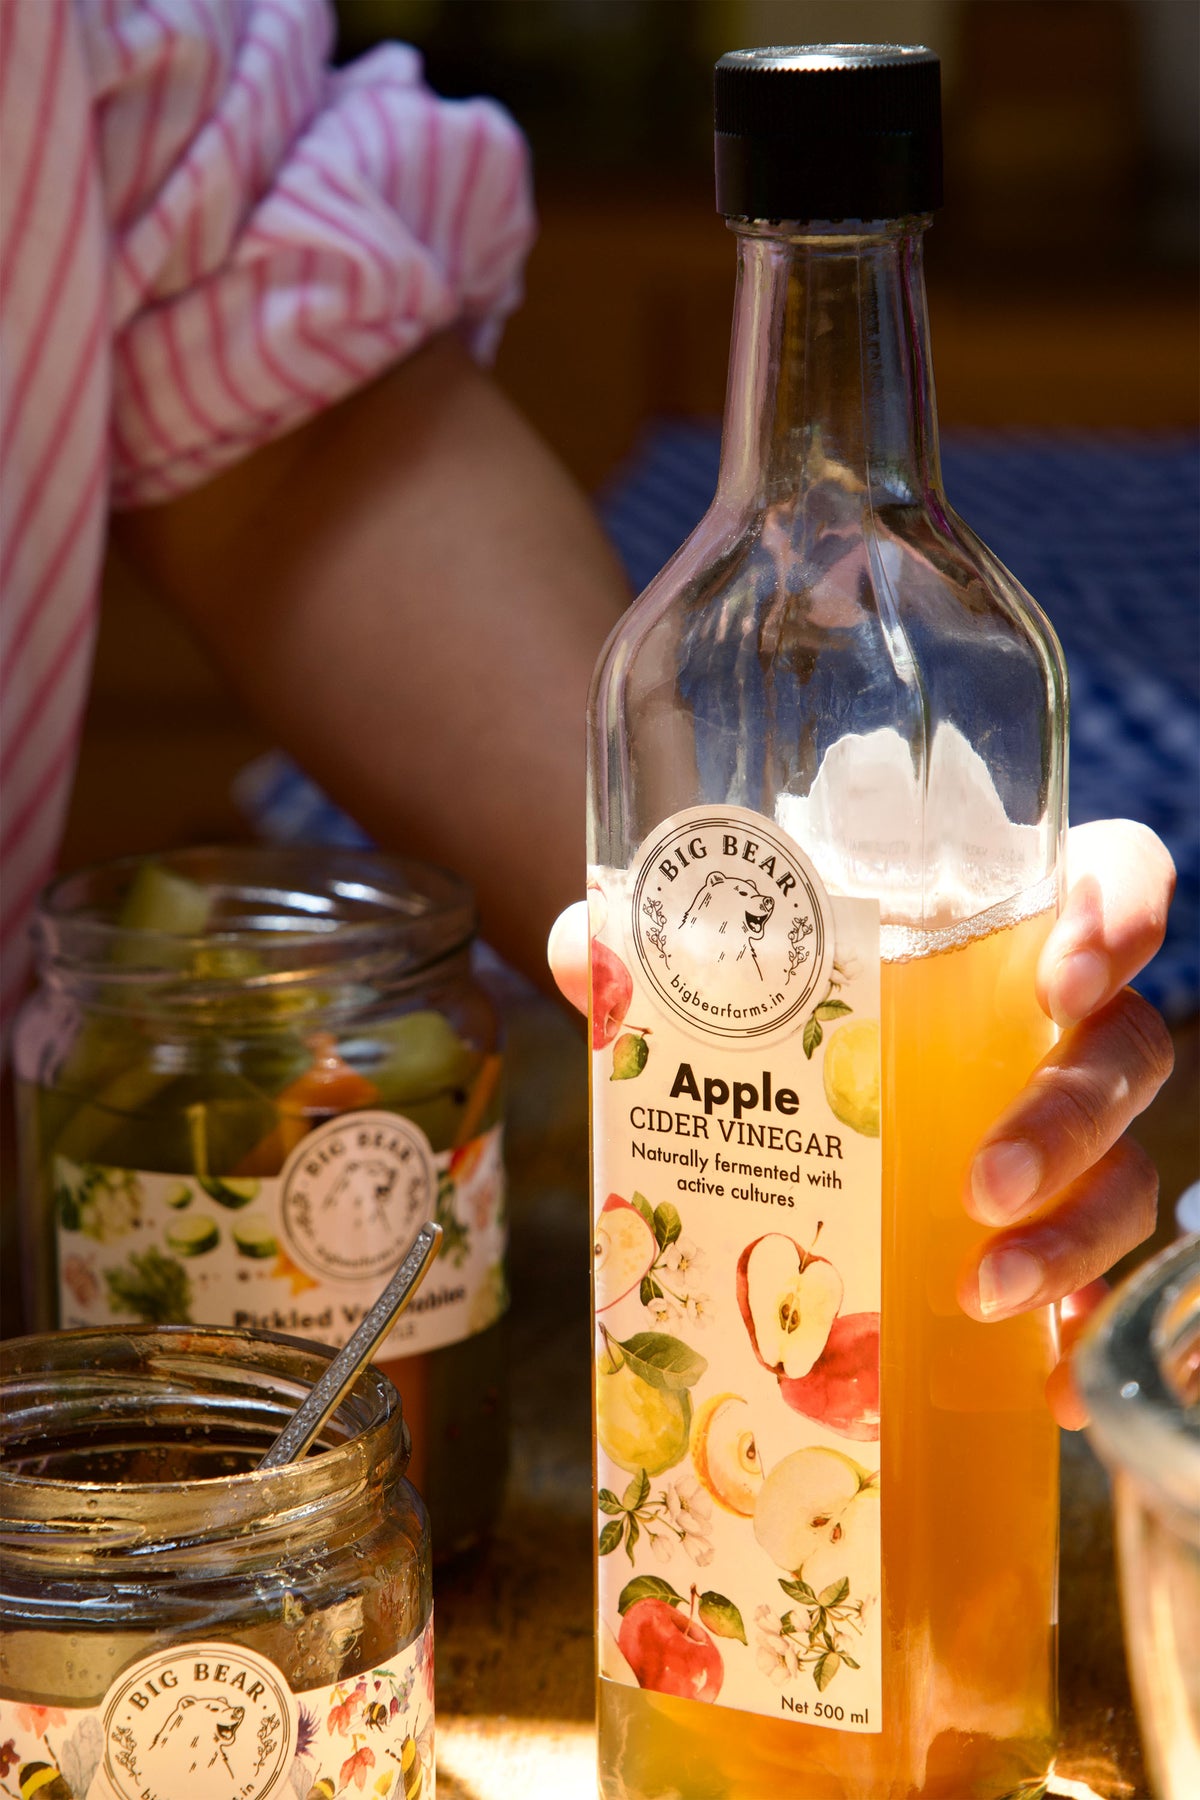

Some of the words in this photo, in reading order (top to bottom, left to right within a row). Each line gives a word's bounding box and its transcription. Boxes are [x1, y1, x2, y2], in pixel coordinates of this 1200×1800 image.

[658, 837, 708, 882] BIG
[722, 834, 797, 897] BEAR
[670, 974, 785, 1019] bigbearfarms.in
[669, 1062, 800, 1119] Apple
[630, 1106, 709, 1139] CIDER
[717, 1119, 844, 1160] VINEGAR
[631, 1141, 709, 1173] Naturally
[715, 1153, 800, 1183] fermented
[807, 1170, 842, 1190] with
[677, 1176, 725, 1197] active
[731, 1183, 795, 1208] cultures
[128, 1669, 179, 1712] BIG
[193, 1663, 267, 1704] BEAR
[781, 1695, 809, 1715] Net
[813, 1702, 845, 1721] 500
[850, 1708, 869, 1724] ml
